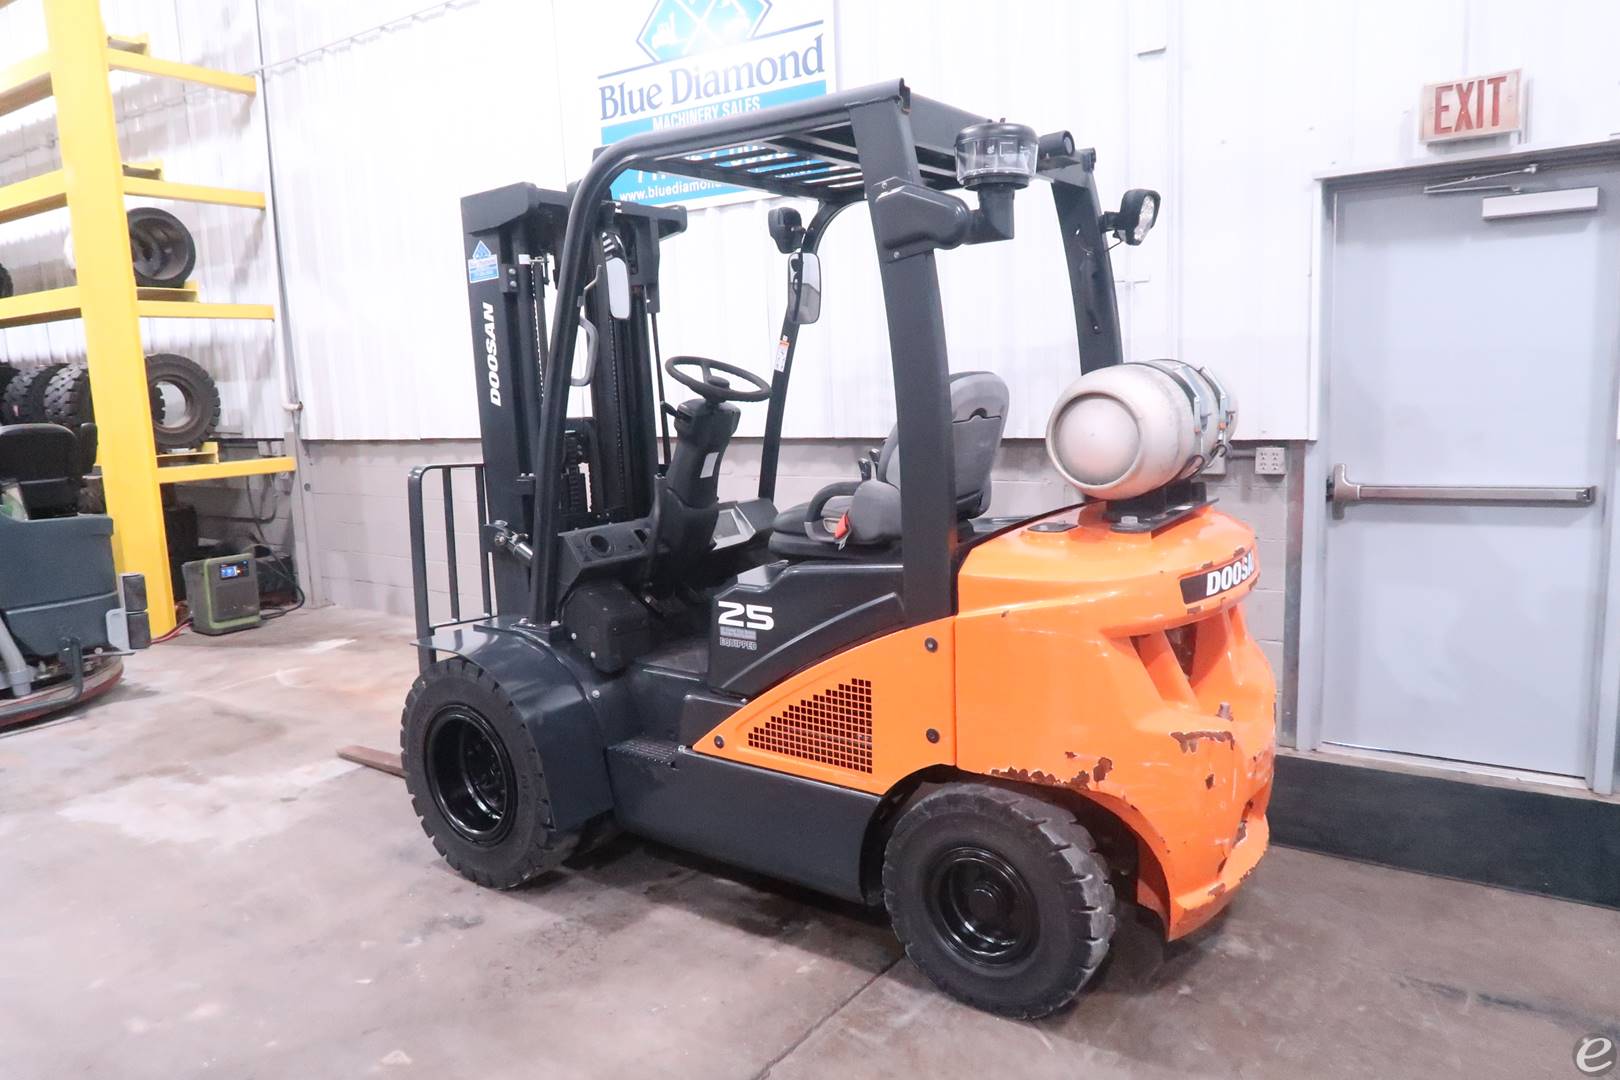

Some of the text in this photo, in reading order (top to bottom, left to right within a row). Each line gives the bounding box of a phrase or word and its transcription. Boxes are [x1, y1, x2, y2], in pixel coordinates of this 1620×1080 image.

[599, 33, 825, 121] Blue Diamond
[652, 96, 761, 130] MACHINERY SALES
[1434, 76, 1507, 135] EXIT
[619, 180, 722, 201] www.bluediamo
[482, 301, 501, 407] DOOSAN
[718, 601, 775, 631] 25
